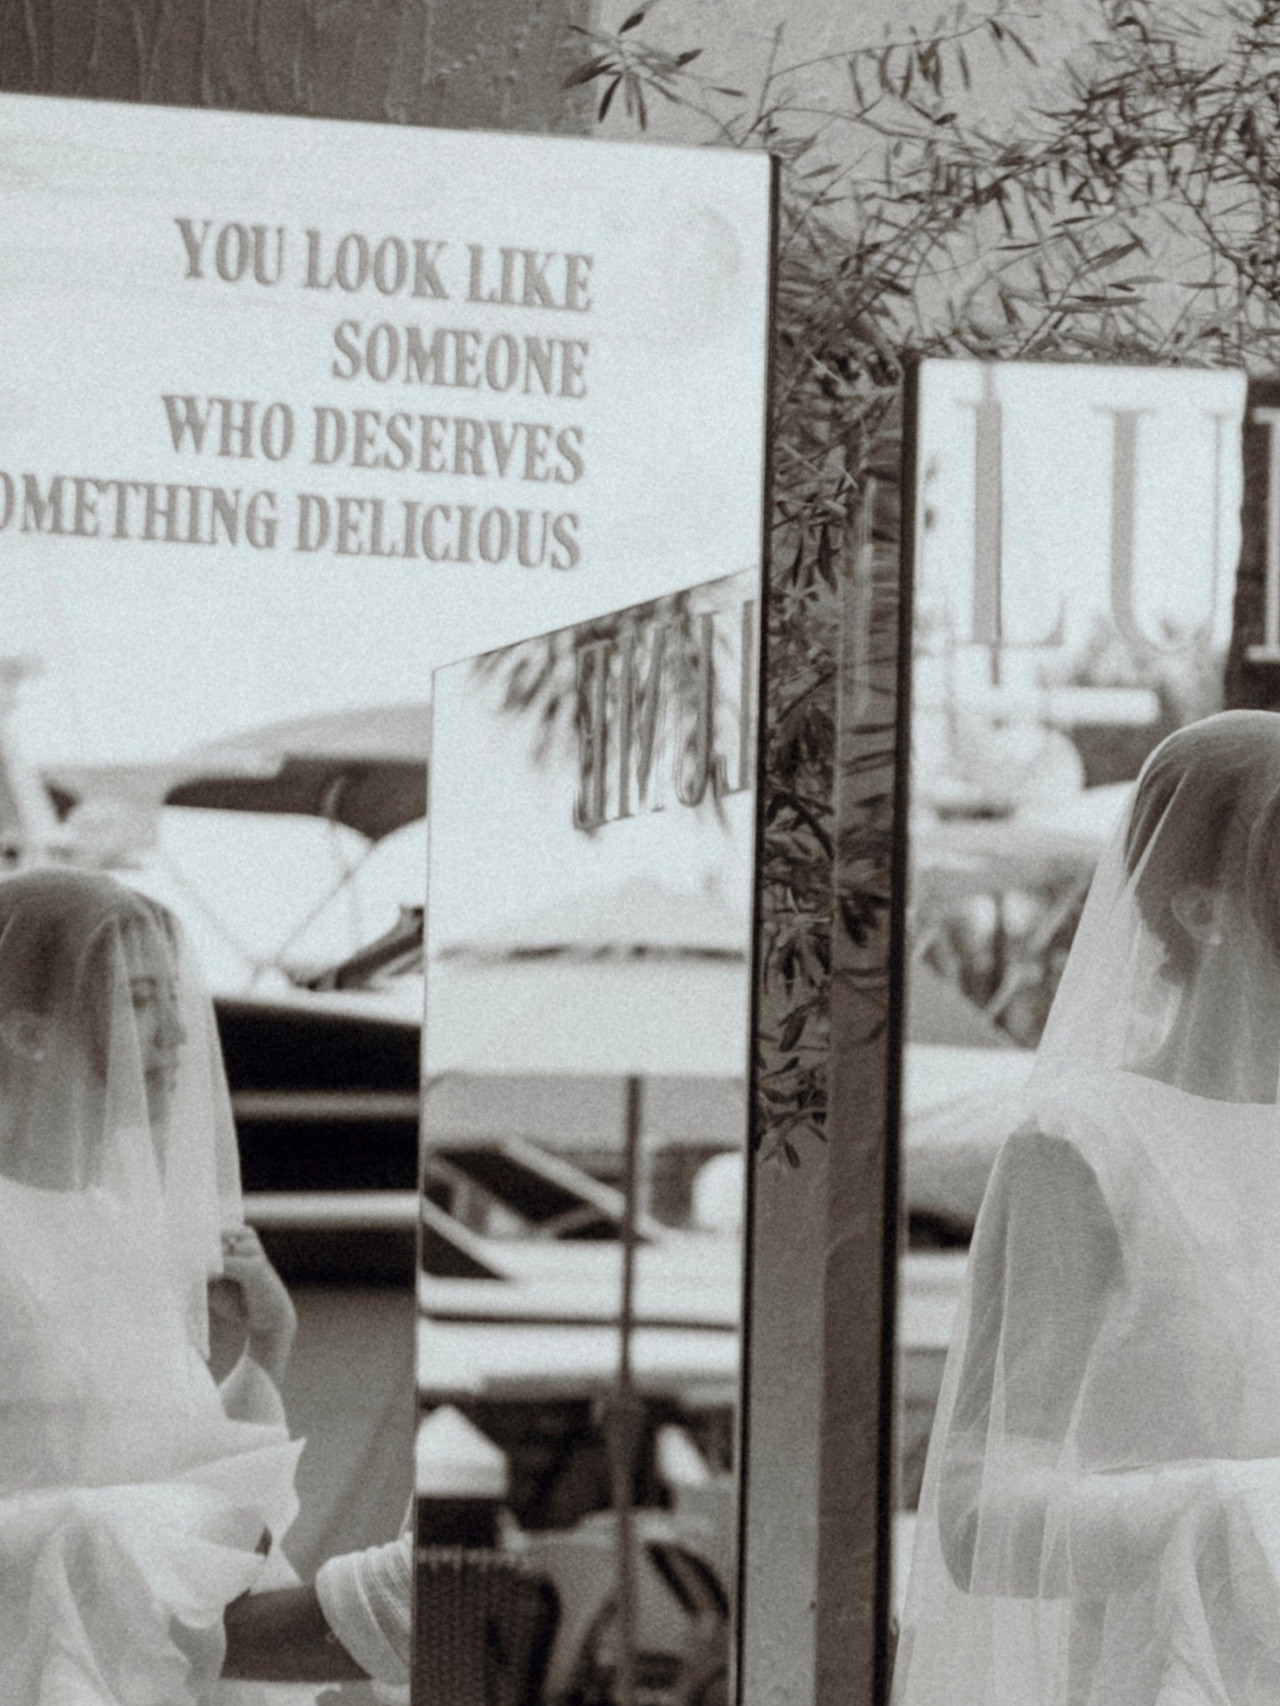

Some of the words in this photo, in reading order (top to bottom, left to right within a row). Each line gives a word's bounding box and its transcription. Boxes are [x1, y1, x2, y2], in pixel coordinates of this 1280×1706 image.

[173, 215, 285, 287] YOU
[303, 228, 450, 301] LOOK
[466, 243, 594, 313] LIKE
[331, 318, 589, 400] SOMEONE
[160, 393, 295, 462] WHO
[312, 405, 585, 485] DESERVES
[294, 492, 581, 572] DELICIOUS
